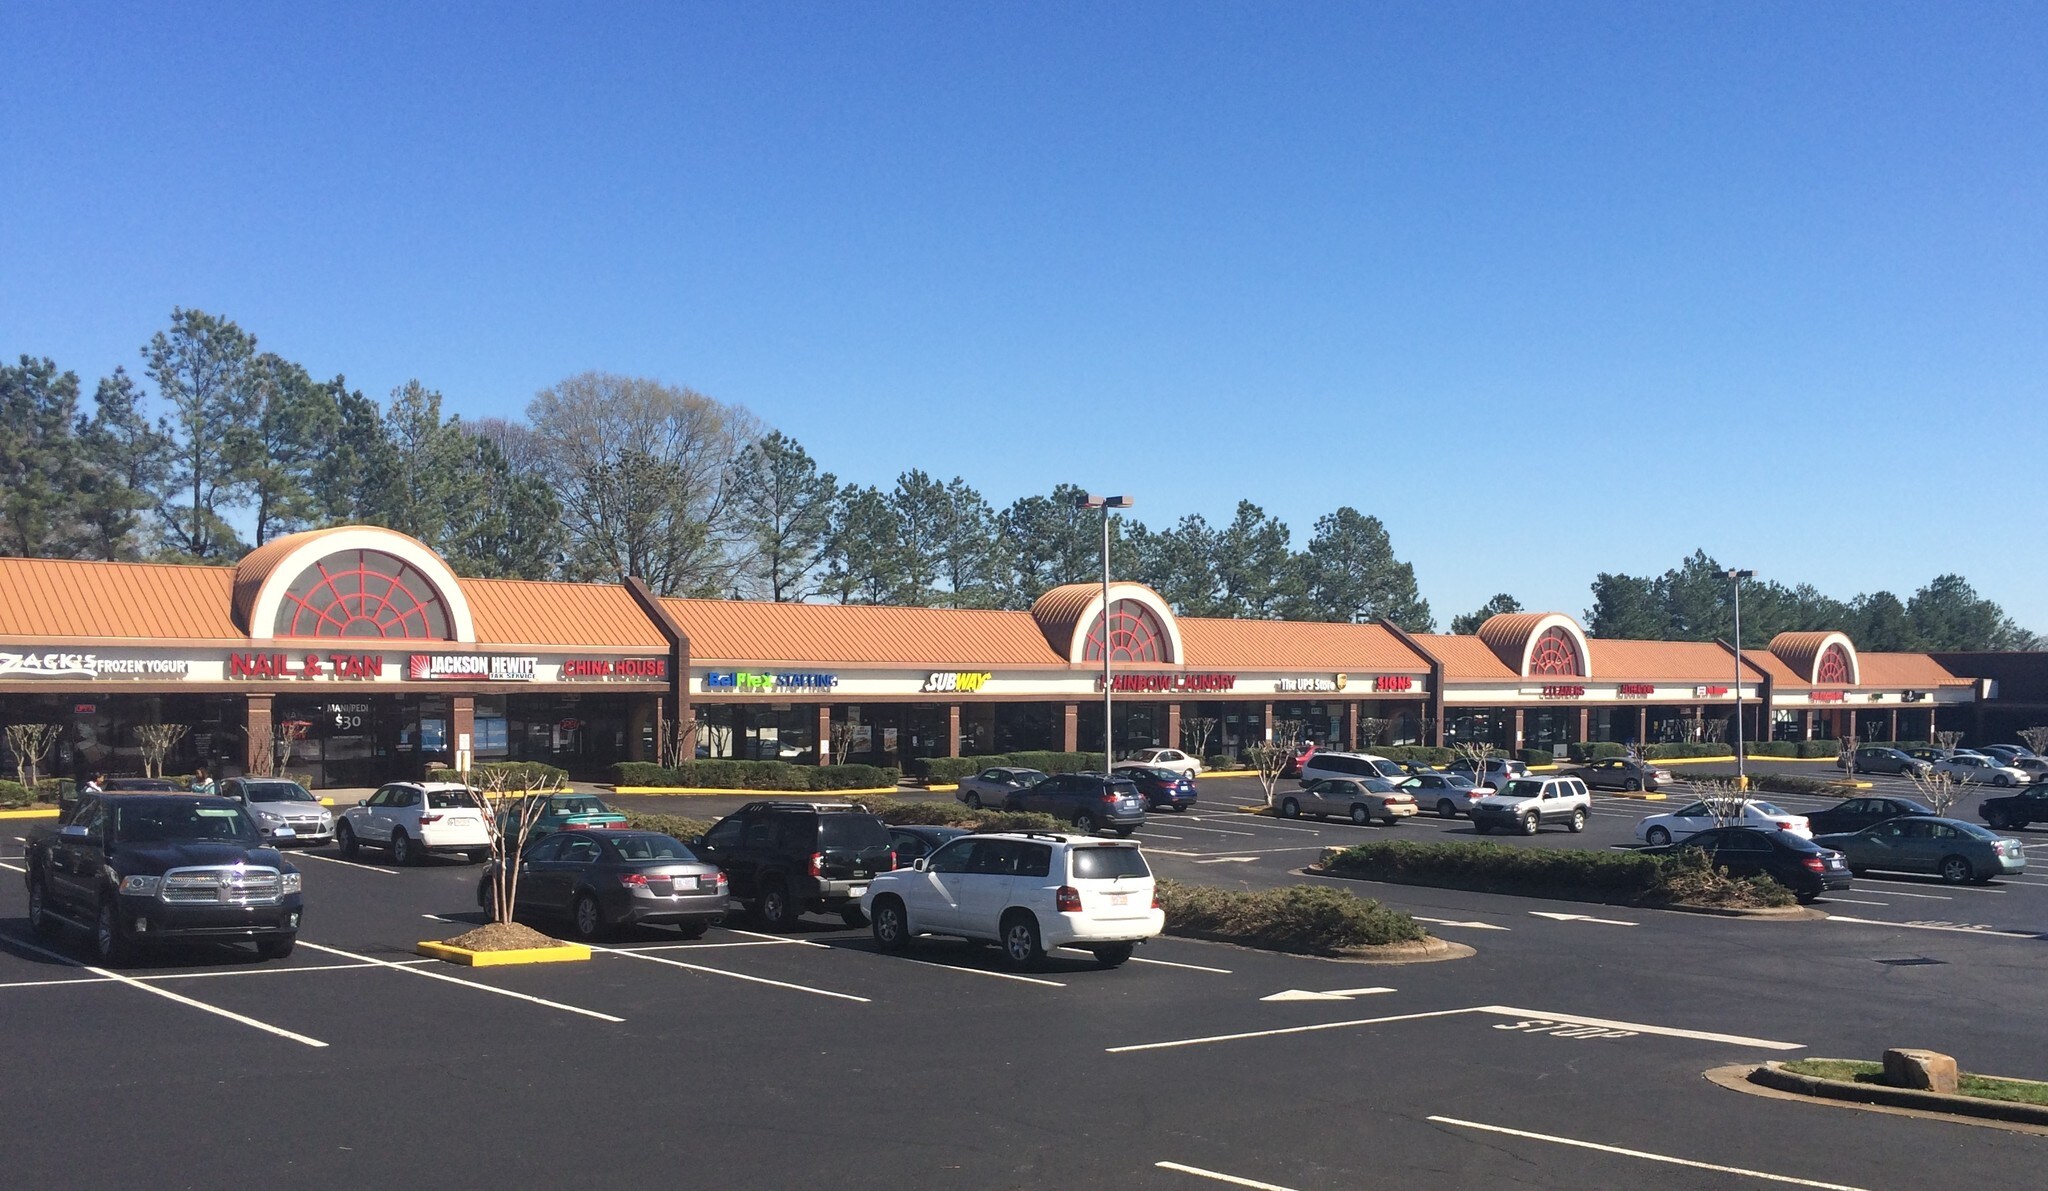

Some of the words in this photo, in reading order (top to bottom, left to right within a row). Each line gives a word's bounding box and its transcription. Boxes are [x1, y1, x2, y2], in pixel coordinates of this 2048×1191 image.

[98, 659, 143, 673] FROZEN
[145, 659, 190, 673] YOGURT
[230, 653, 297, 676] NAIL
[304, 655, 323, 676] &
[329, 655, 382, 677] TAN
[430, 656, 488, 674] JACKSON
[491, 656, 538, 674] HEWITT
[564, 660, 610, 676] CHINA
[615, 660, 665, 676] HOUSE
[776, 673, 838, 687] STAFFING
[925, 672, 992, 691] SUBWAY
[1174, 675, 1237, 689] LAUNDRY
[1297, 679, 1314, 690] UPS
[1376, 676, 1412, 690] SIGNS
[335, 713, 361, 730] $30
[1492, 1020, 1639, 1039] STOP
